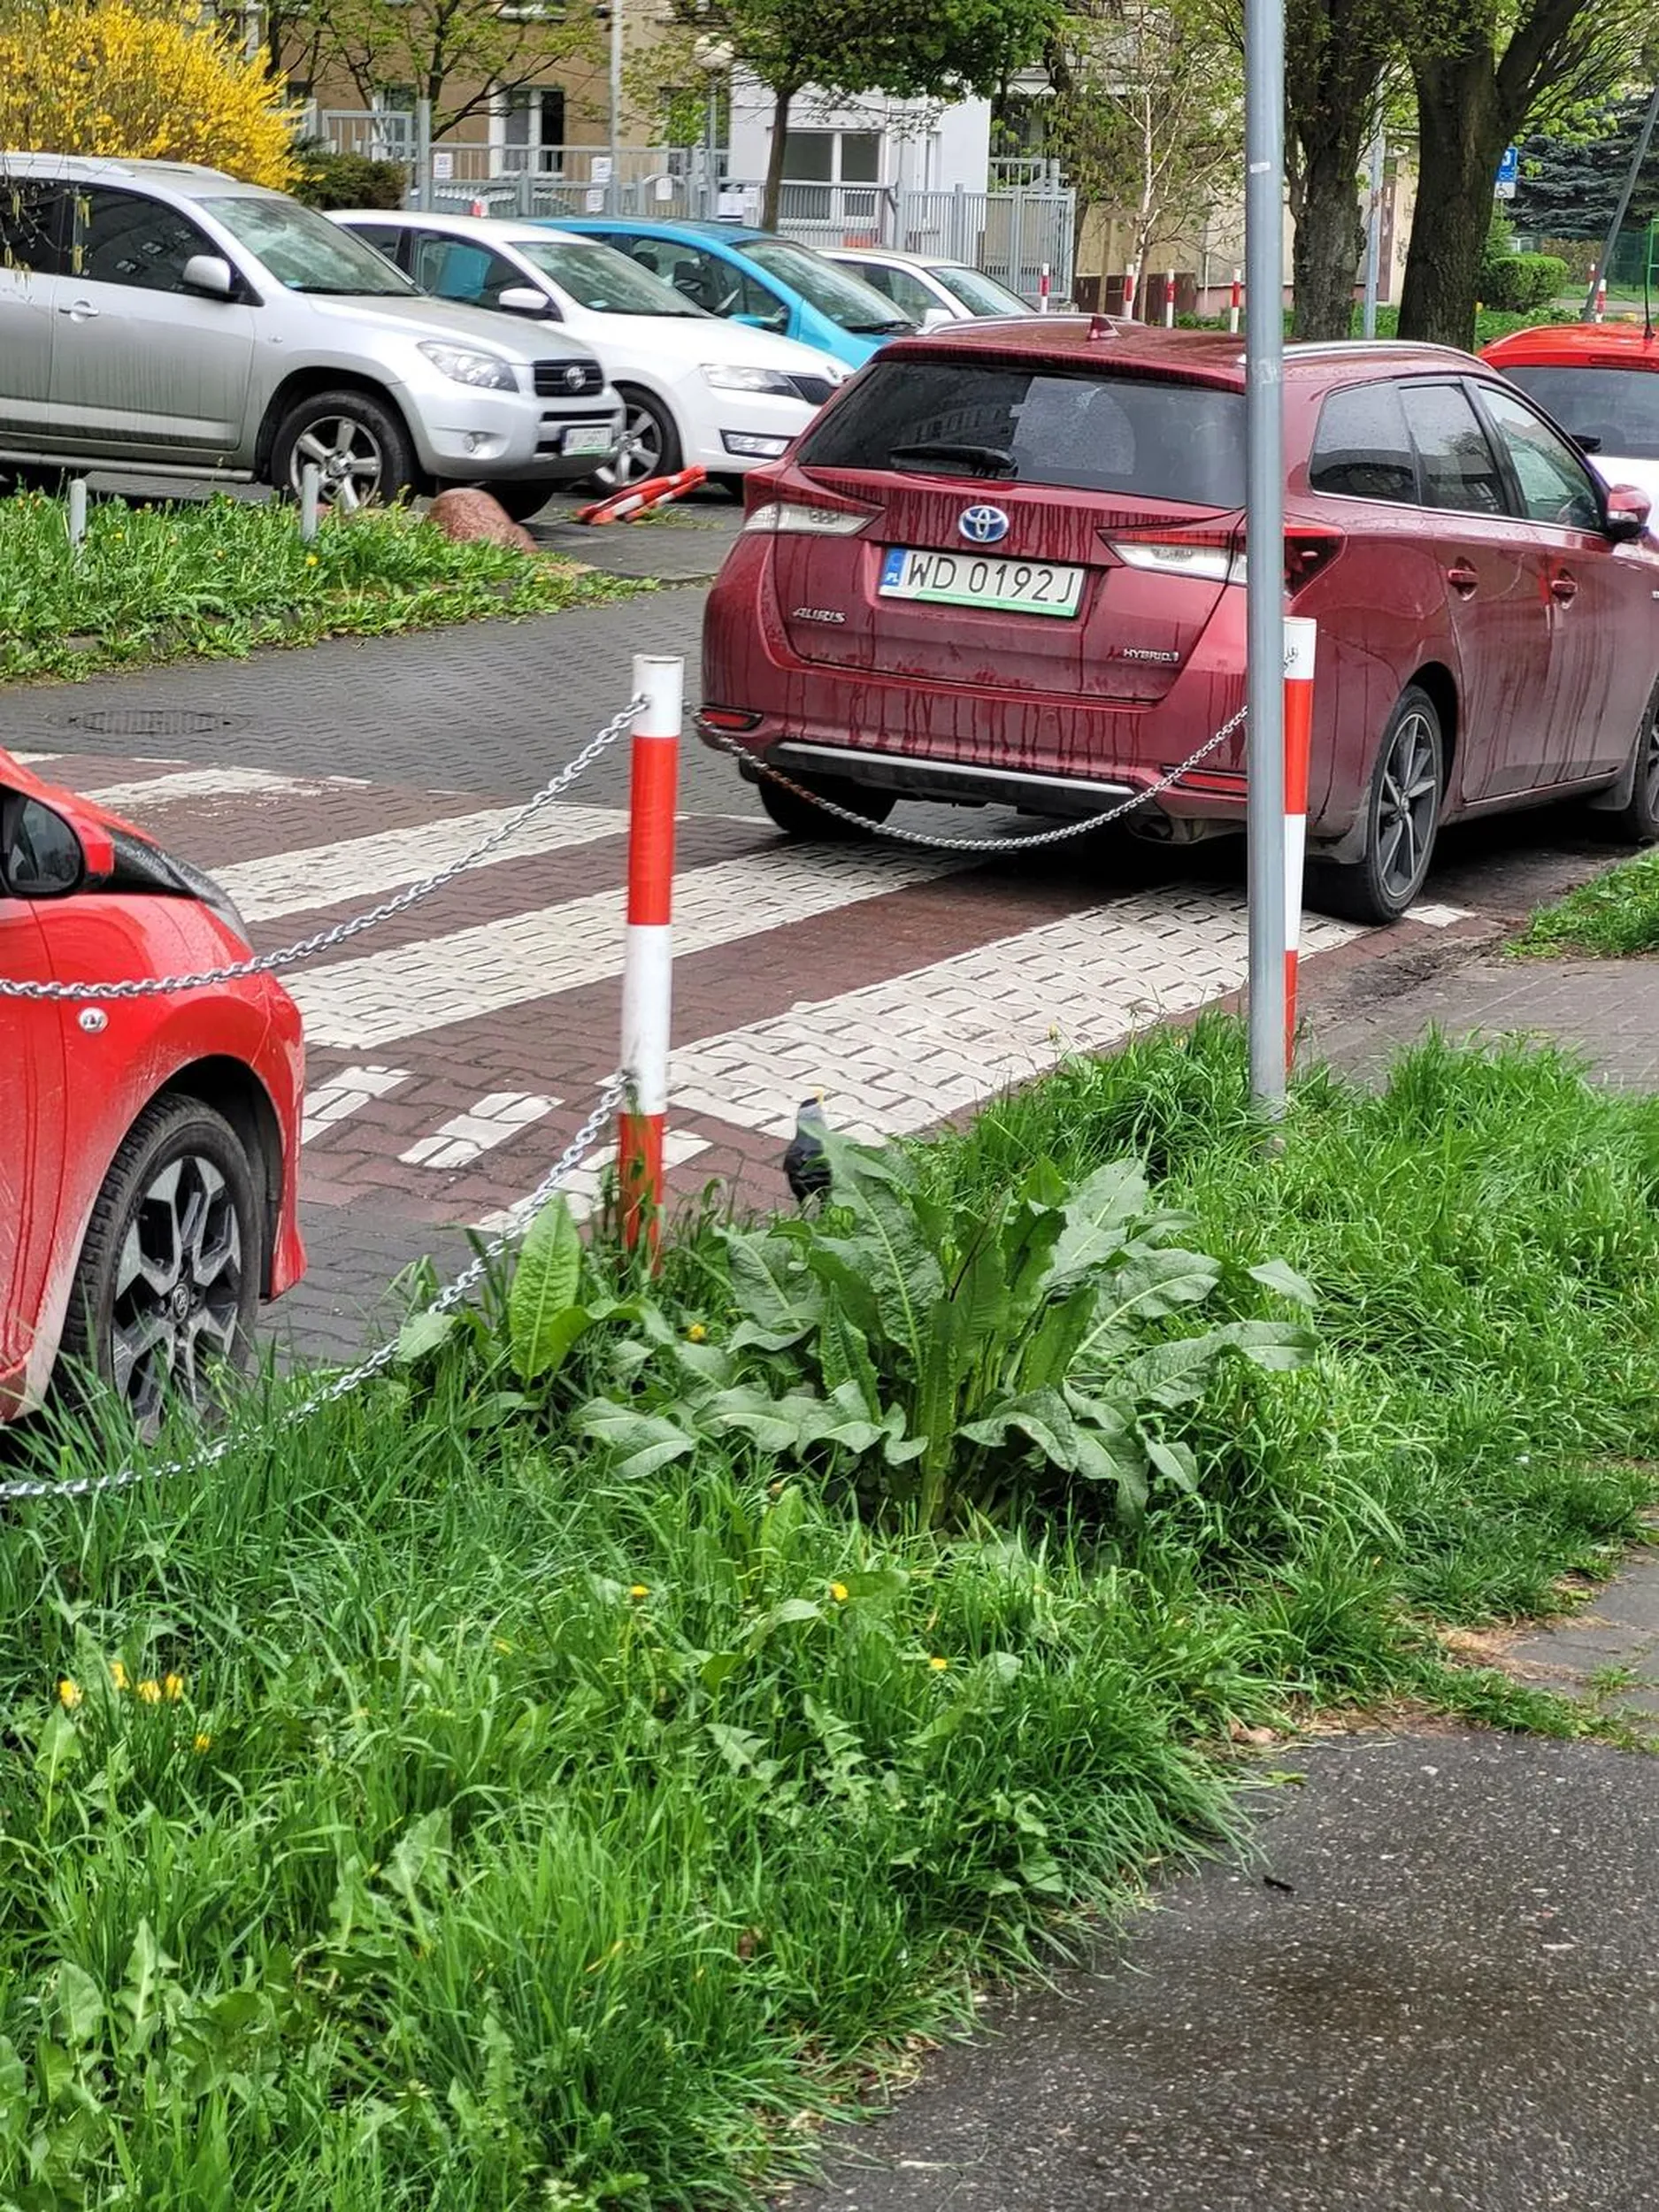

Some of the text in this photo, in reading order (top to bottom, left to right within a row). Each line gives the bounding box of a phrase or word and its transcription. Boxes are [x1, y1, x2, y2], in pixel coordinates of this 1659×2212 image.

[907, 553, 1076, 603] WD 0192J
[792, 607, 846, 623] AURIS
[1123, 648, 1172, 662] HYBRID
